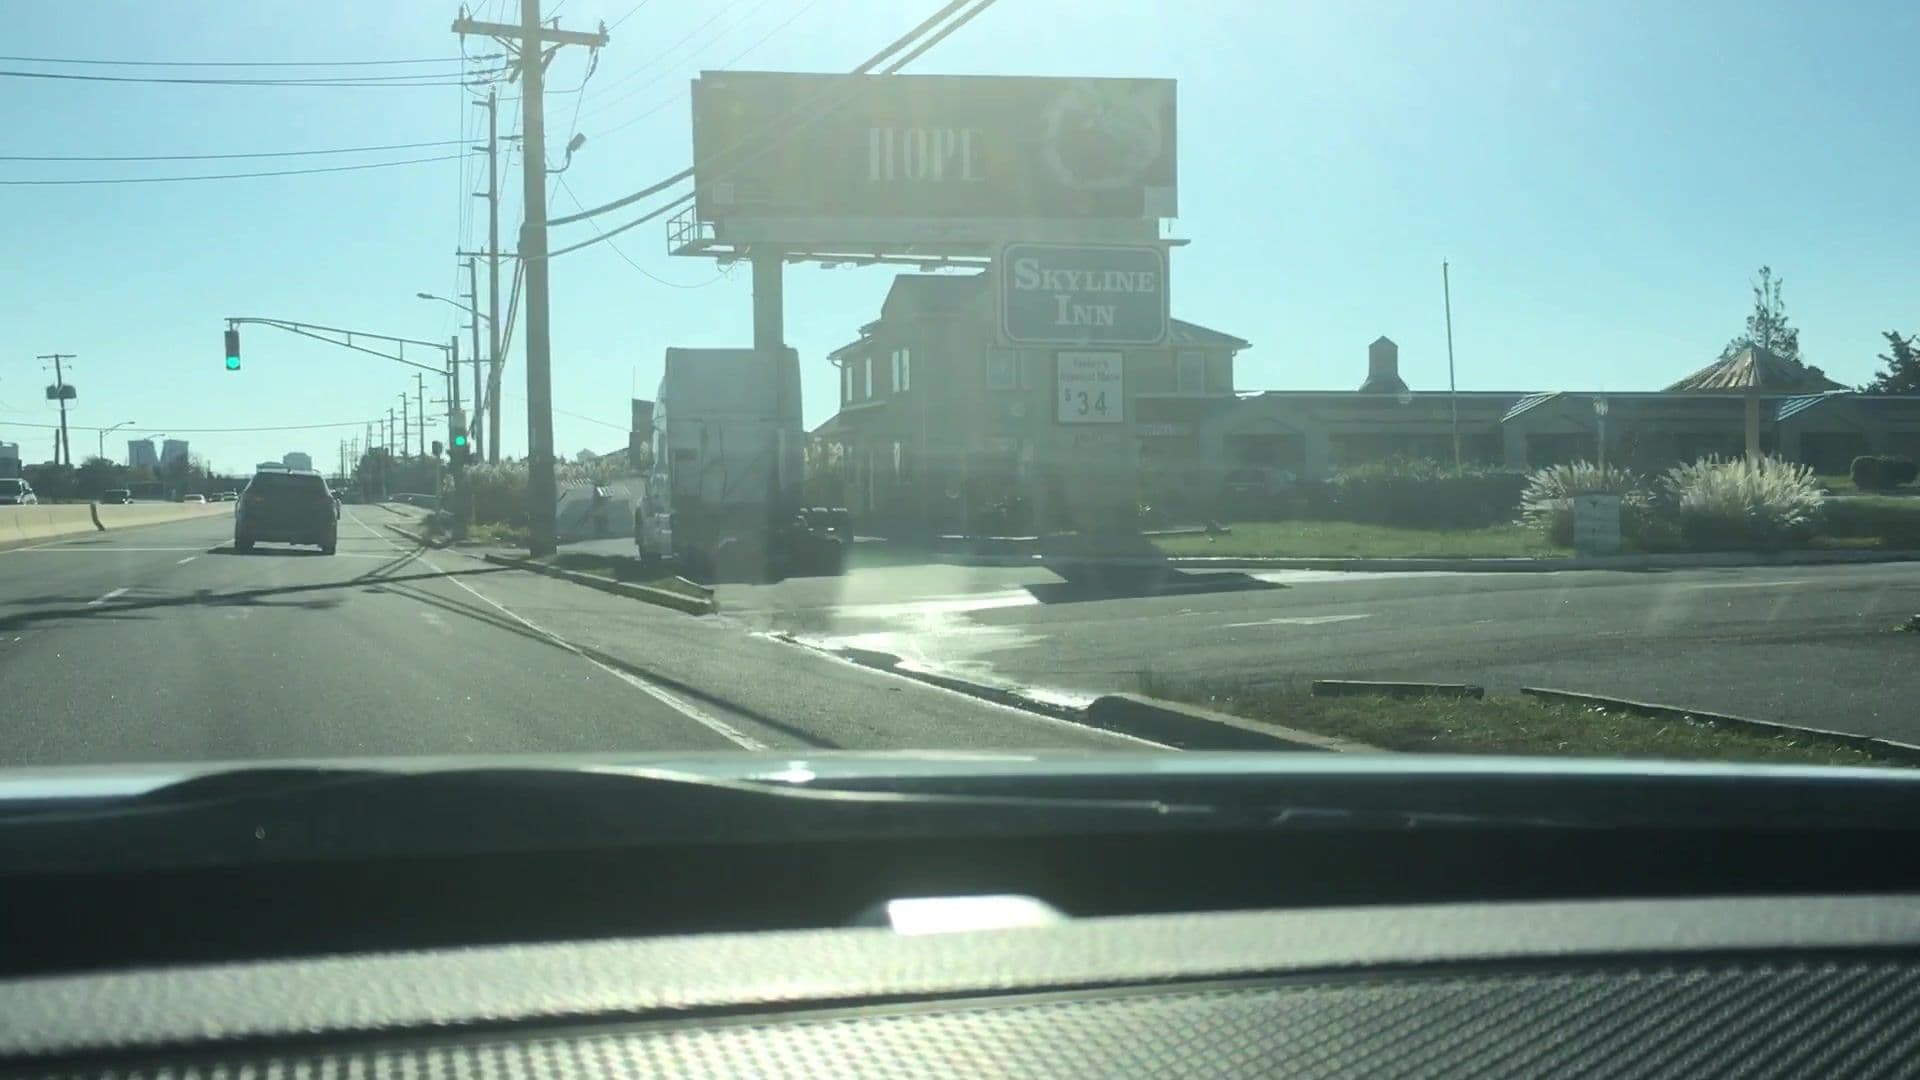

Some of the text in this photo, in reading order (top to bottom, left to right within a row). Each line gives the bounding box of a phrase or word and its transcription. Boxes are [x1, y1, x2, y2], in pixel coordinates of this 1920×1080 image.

[867, 127, 985, 182] HOPE
[1014, 258, 1155, 292] SKYLINE
[1055, 294, 1117, 326] INN
